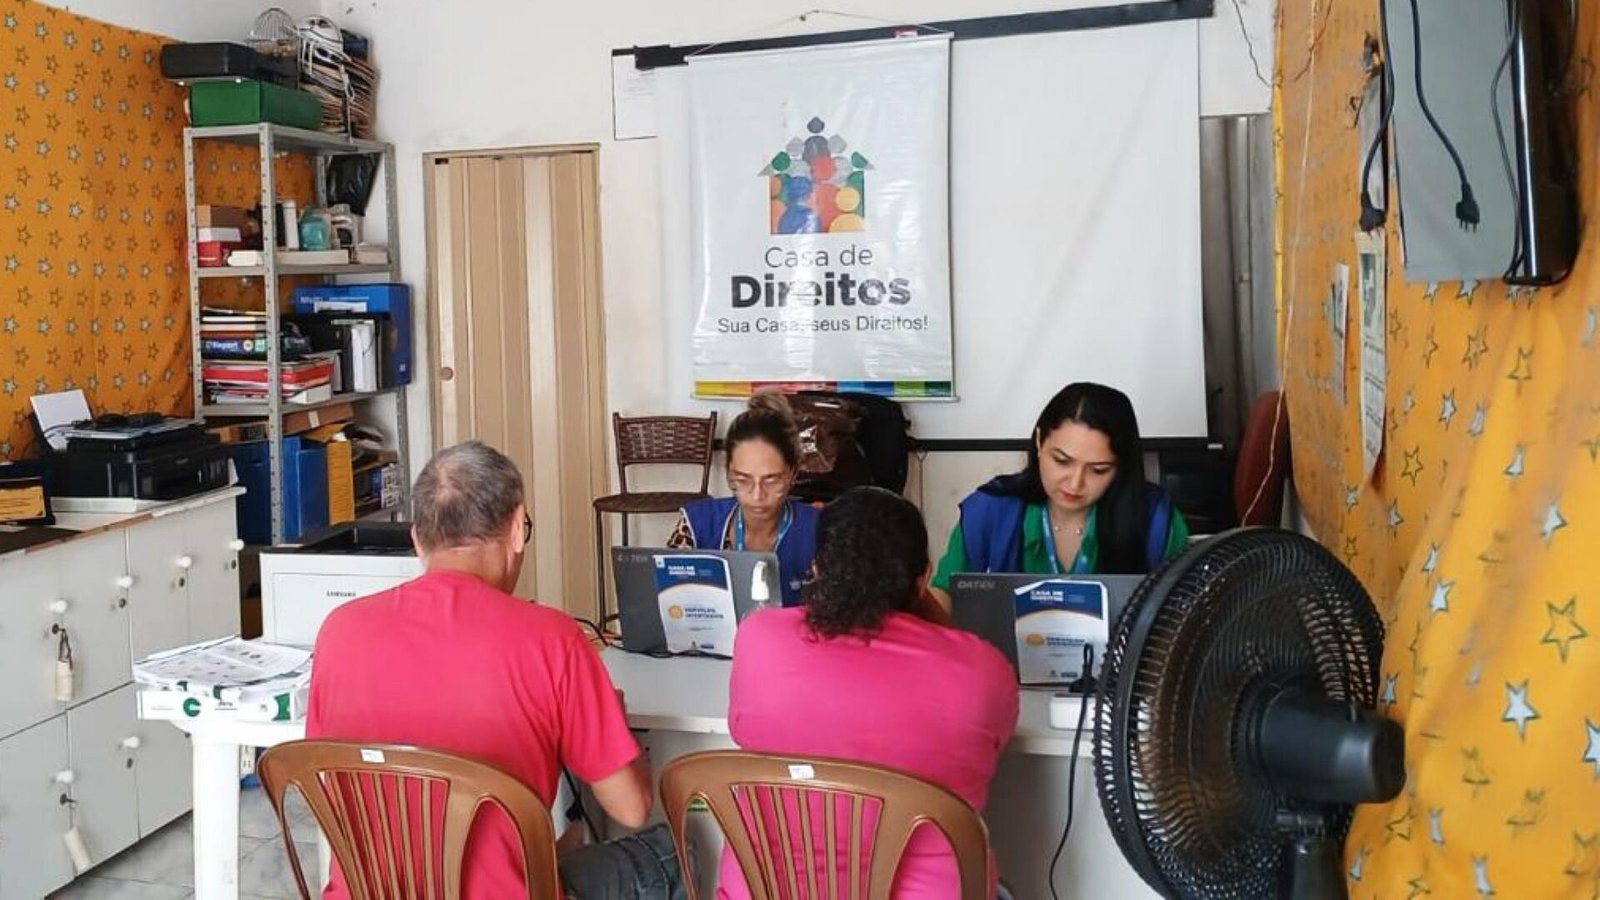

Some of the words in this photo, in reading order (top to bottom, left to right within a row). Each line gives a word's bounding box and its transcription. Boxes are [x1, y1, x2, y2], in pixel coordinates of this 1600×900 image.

[765, 246, 829, 268] Casa
[839, 244, 873, 266] de
[731, 271, 911, 308] Direitos
[718, 318, 750, 333] Sua
[810, 319, 850, 332] seus
[857, 315, 929, 331] Direitos!
